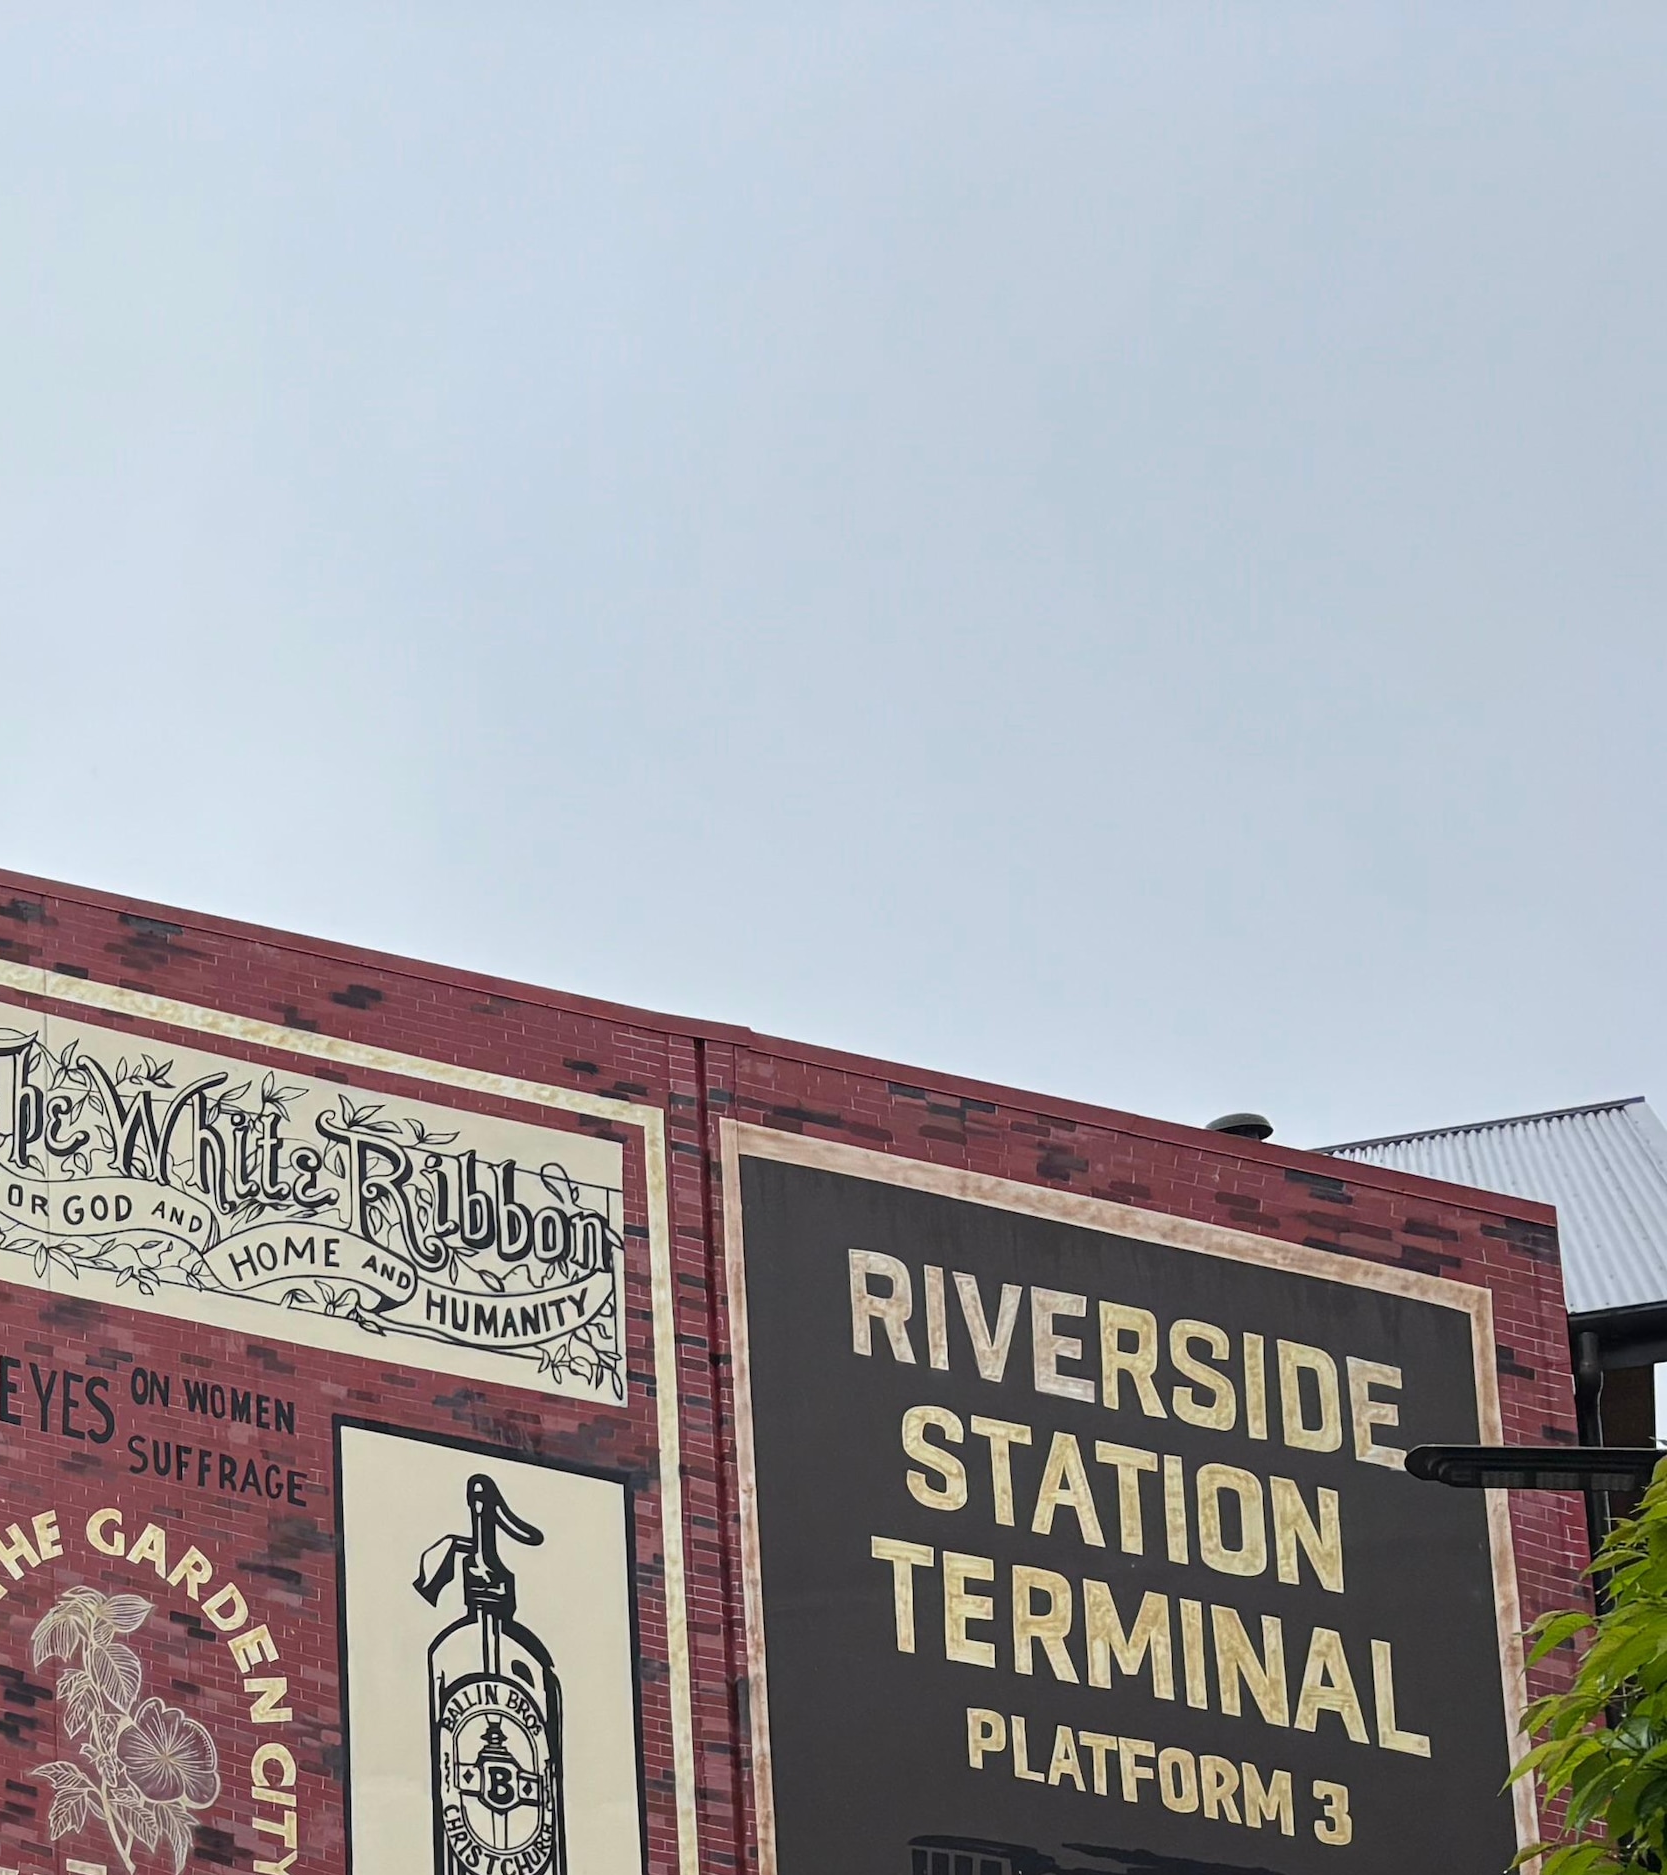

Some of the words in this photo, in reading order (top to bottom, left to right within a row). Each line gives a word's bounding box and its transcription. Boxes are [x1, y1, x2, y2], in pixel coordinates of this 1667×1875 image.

[77, 1056, 330, 1213] White
[316, 1111, 612, 1273] Ribbon
[67, 1194, 133, 1225] GOD
[151, 1202, 204, 1234] AND
[230, 1236, 341, 1280] HOME
[362, 1254, 413, 1290] AND
[425, 1287, 591, 1340] HUMANITY
[30, 1370, 116, 1445] YES
[130, 1368, 170, 1406] ON
[185, 1380, 295, 1434] WOMEN
[848, 1248, 1409, 1472] RIVERSIDE
[128, 1436, 309, 1508] SUFFRAGE
[901, 1404, 1344, 1594] STATION
[86, 1506, 292, 1726] GARDEN
[871, 1535, 1431, 1759] TERMINAL
[443, 1684, 499, 1734] BALLIN
[966, 1706, 1295, 1837] PLATFORM
[1313, 1781, 1353, 1846] 3
